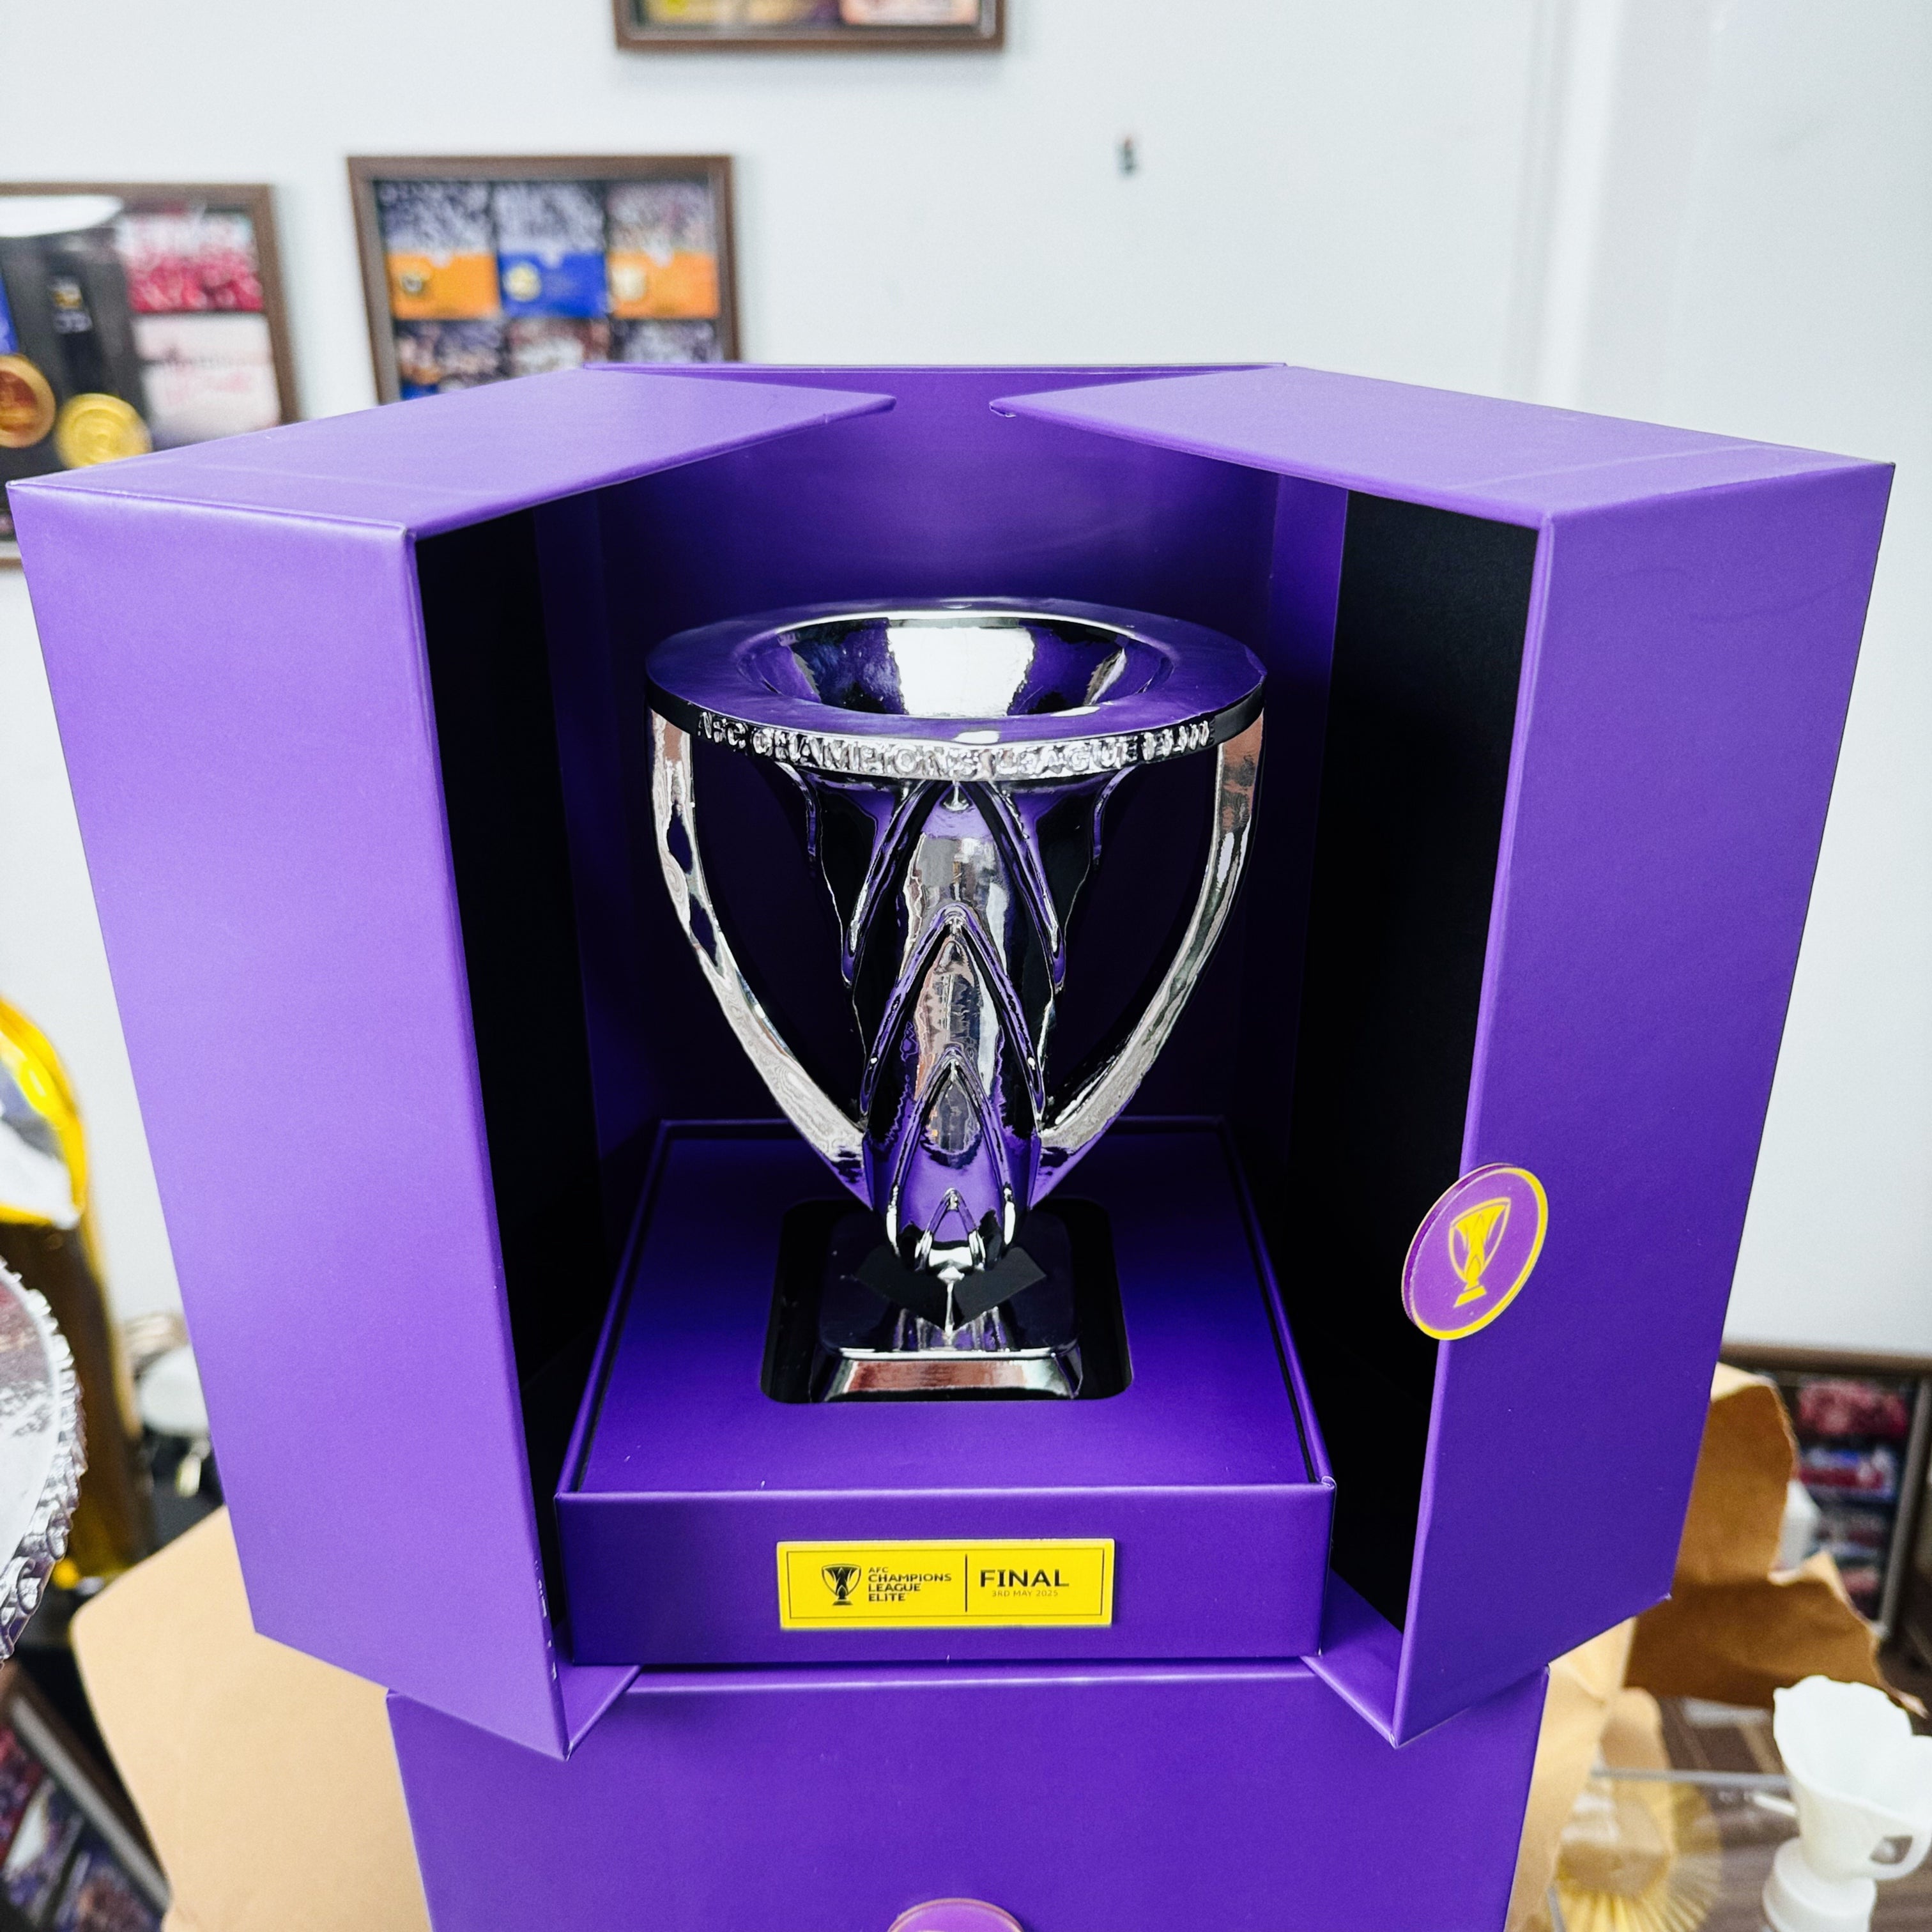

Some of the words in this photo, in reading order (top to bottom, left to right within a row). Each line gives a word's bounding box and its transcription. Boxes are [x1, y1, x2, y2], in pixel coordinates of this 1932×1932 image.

[868, 1574, 952, 1583] CHAMPIONS
[980, 1569, 1070, 1588] FINAL
[868, 1583, 921, 1591] LEAGUE
[868, 1593, 906, 1602] ELITE
